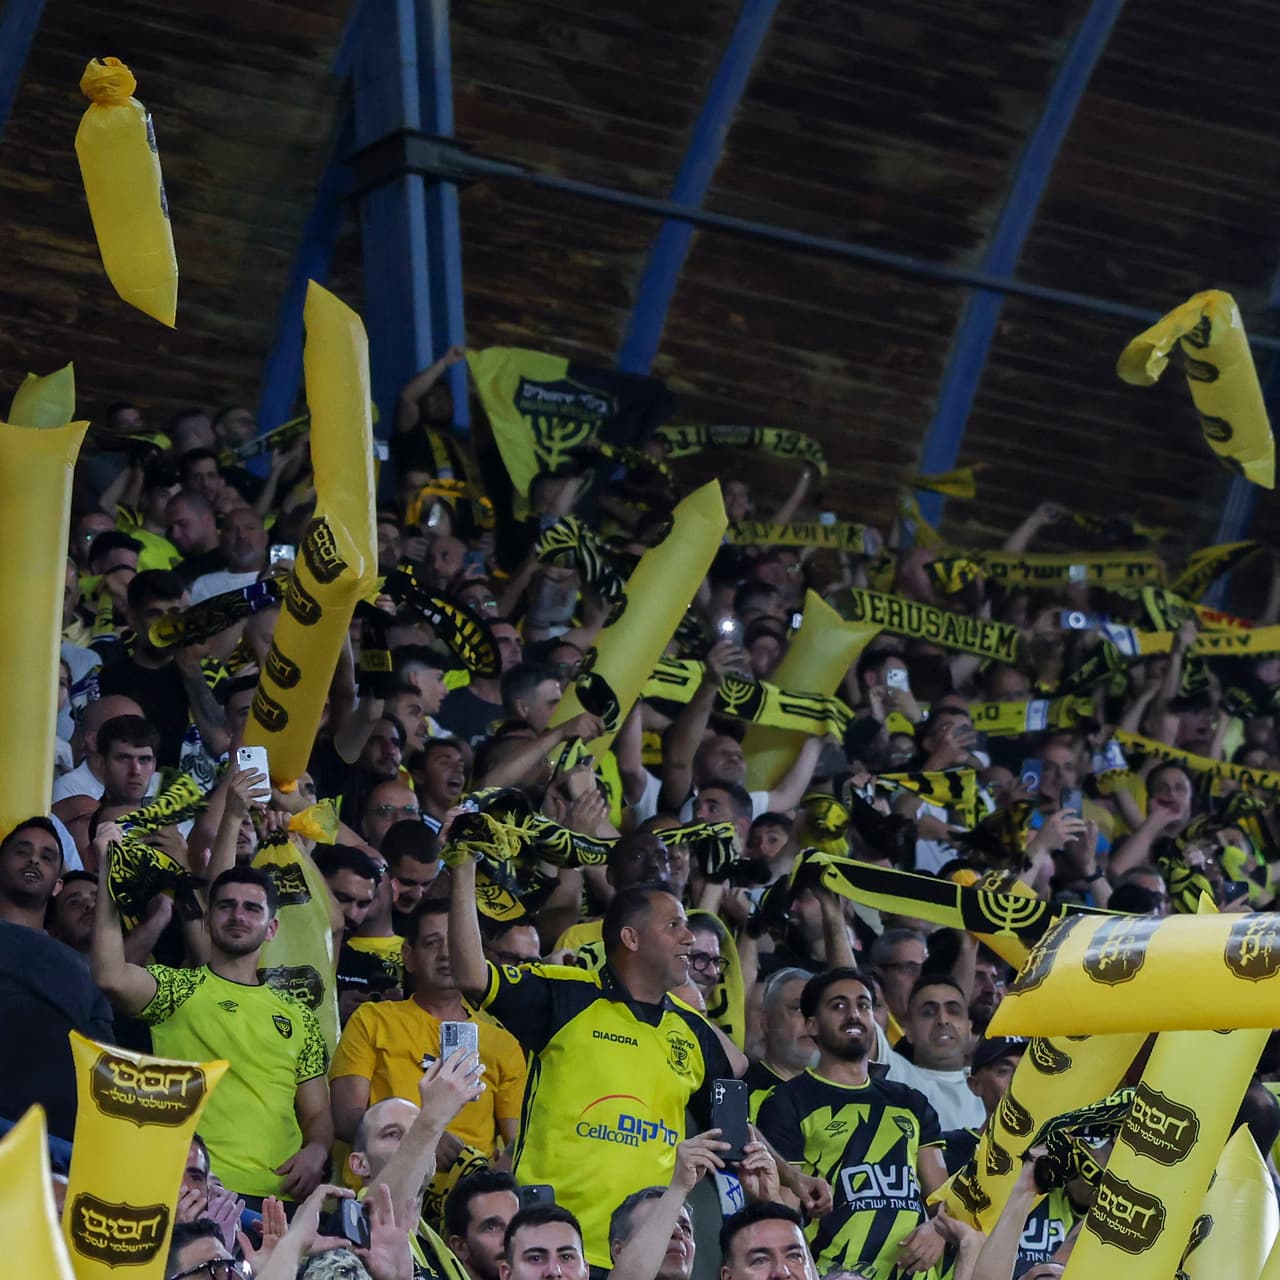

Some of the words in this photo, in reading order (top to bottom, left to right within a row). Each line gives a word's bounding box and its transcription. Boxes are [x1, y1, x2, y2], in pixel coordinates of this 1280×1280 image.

[857, 591, 1015, 657] JERUSALEM
[592, 1030, 640, 1048] DIADORA
[576, 1120, 640, 1148] Cellcom
[617, 1113, 680, 1147] סלקום
[1131, 1096, 1190, 1141] חביב
[81, 1206, 161, 1241] חביבי
[1098, 1183, 1157, 1230] חביב
